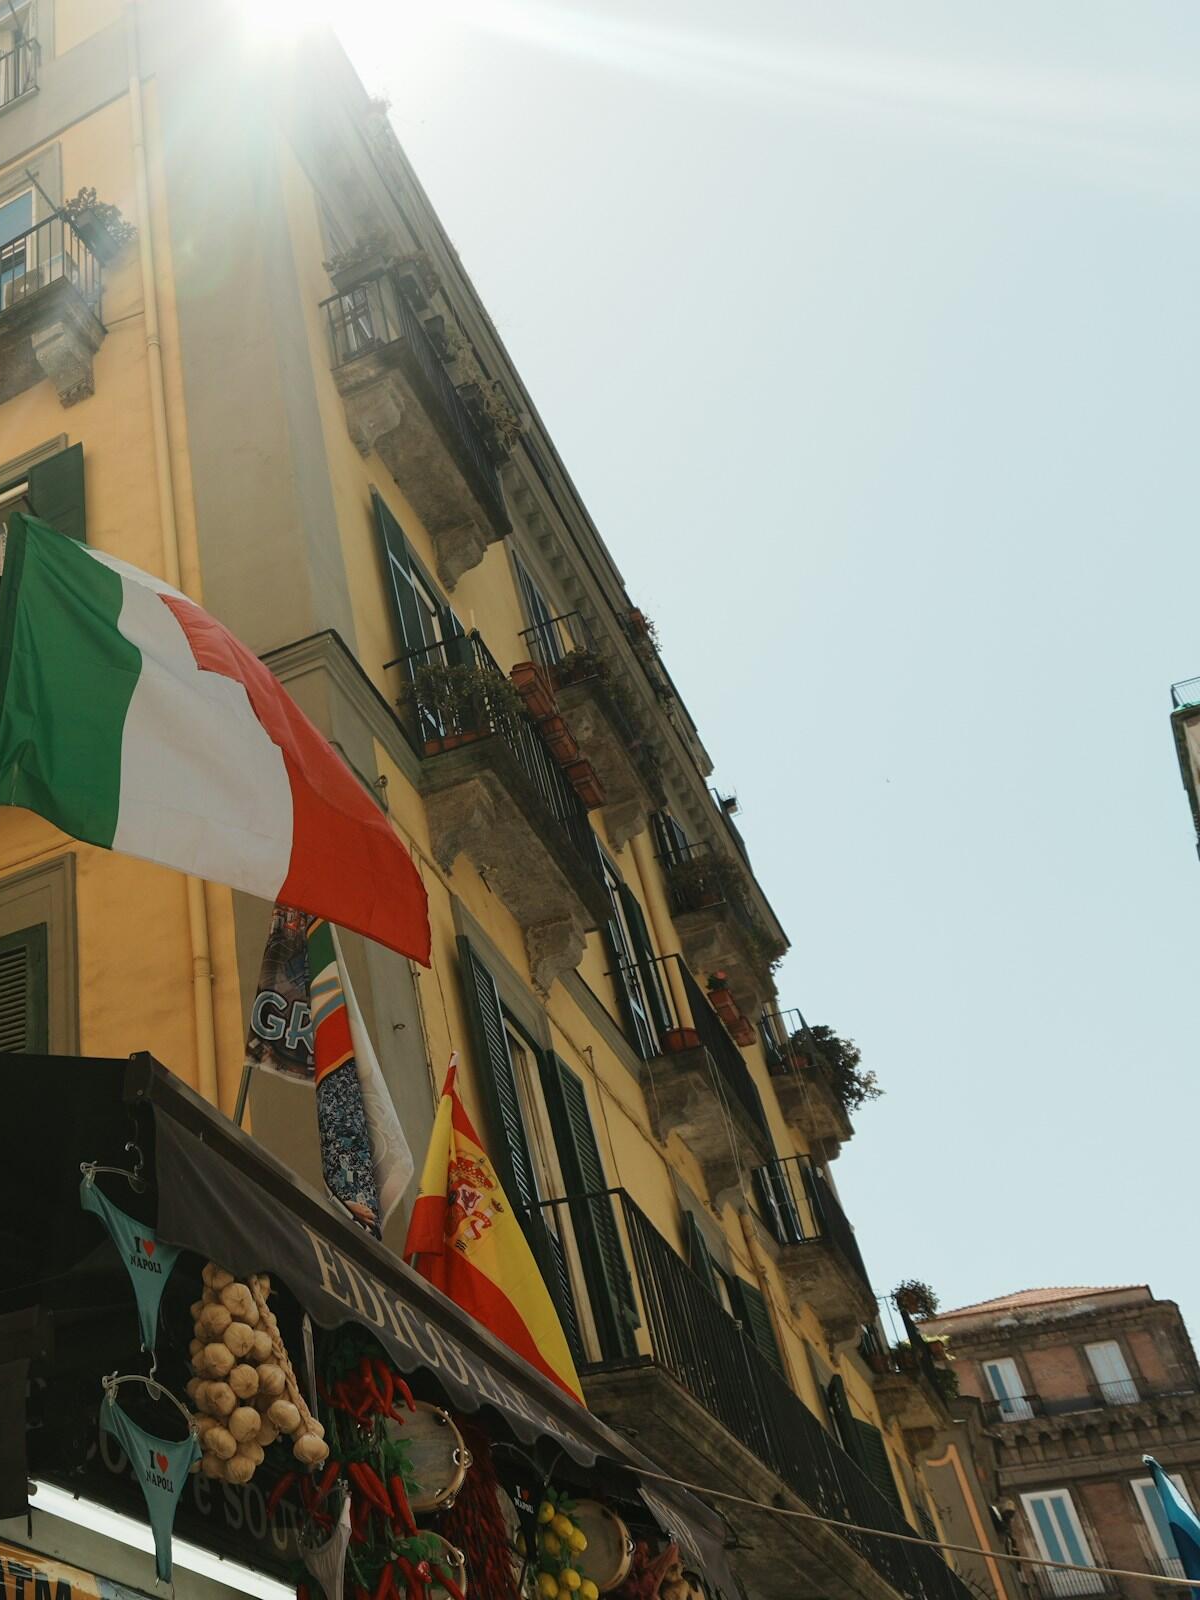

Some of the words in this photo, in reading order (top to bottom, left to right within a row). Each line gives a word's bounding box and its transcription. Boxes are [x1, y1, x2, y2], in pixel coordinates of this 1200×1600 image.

[134, 1236, 141, 1253] I
[130, 1255, 162, 1274] NAPOLI
[149, 1449, 156, 1469] I
[146, 1470, 174, 1493] NAPOLI
